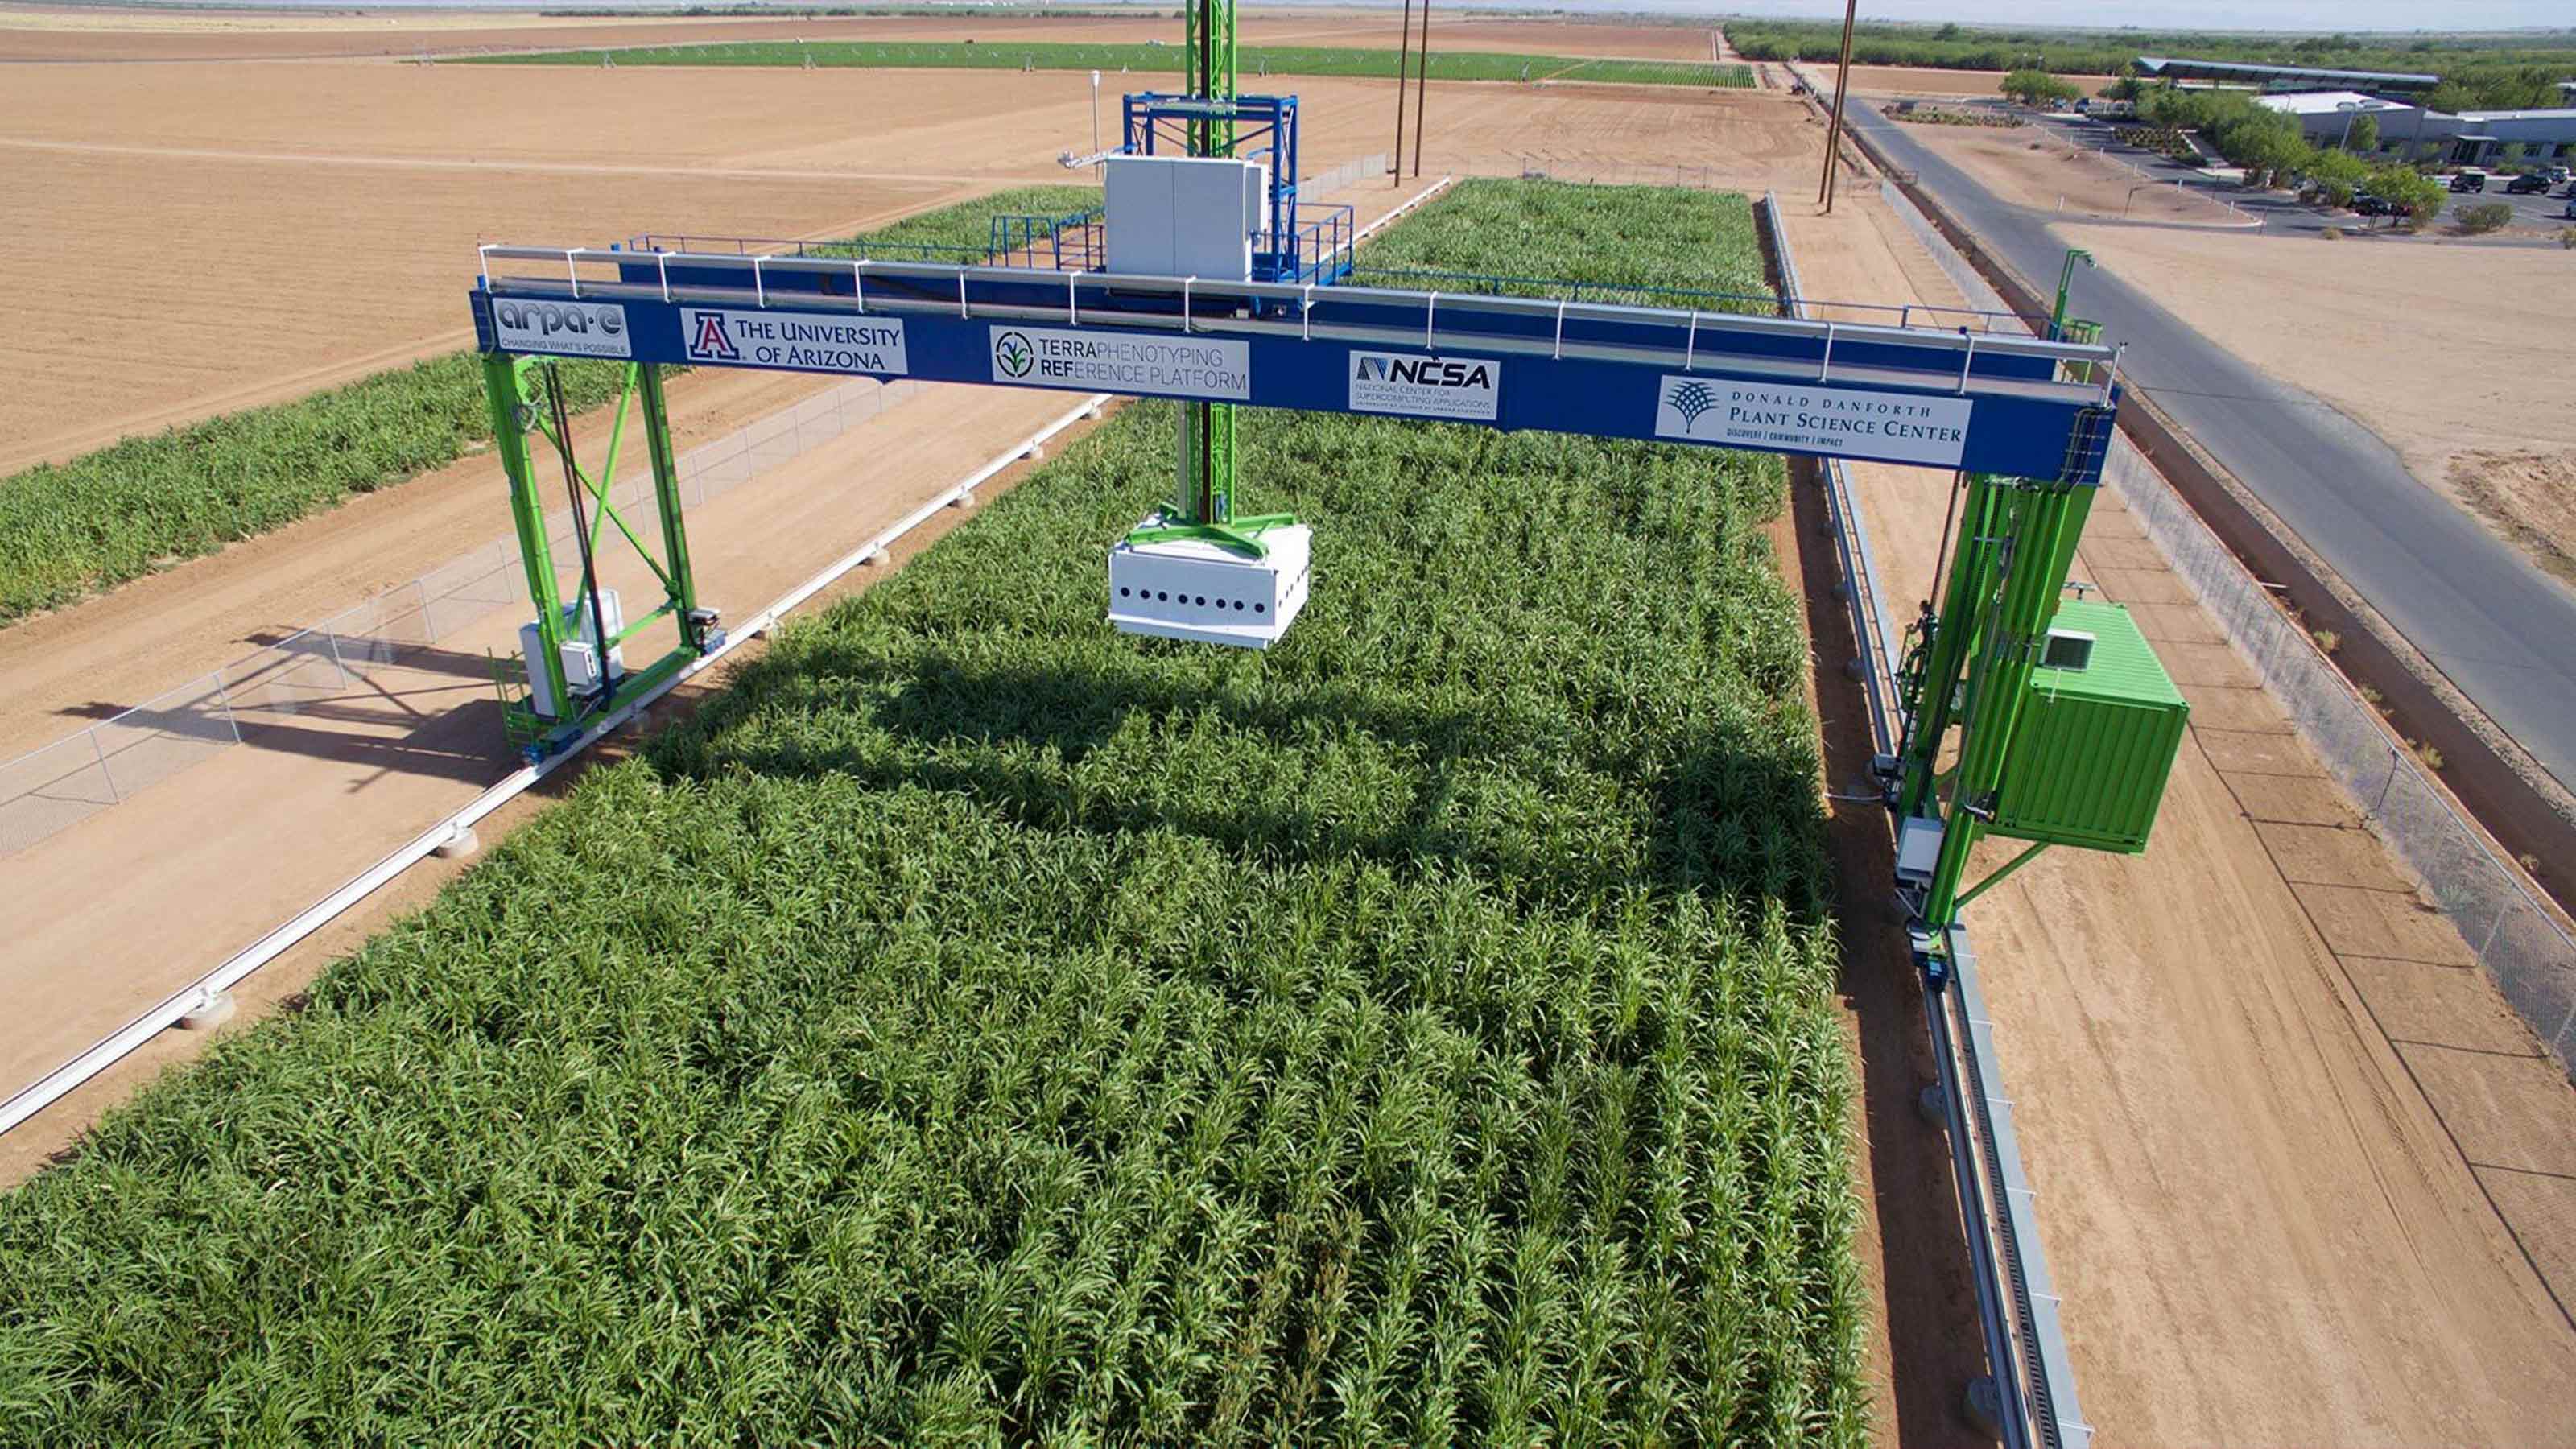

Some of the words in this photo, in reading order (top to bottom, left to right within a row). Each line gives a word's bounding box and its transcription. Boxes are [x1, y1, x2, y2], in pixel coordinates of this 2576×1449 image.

[502, 338, 548, 349] CHANGING
[584, 342, 626, 354] POSSIBLE
[736, 320, 775, 340] THE
[782, 322, 900, 347] UNIVERSITY
[756, 346, 781, 363] OF
[787, 346, 886, 370] ARIZONA
[1041, 360, 1144, 384] REFERENCE
[1150, 366, 1246, 390] PLATFORM
[1389, 359, 1490, 389] NCSA
[1356, 384, 1397, 394] NATIONAL
[1399, 386, 1432, 395] CENTER
[1433, 388, 1450, 397] FOR
[1356, 392, 1430, 404] SUPERCOMPUTING
[1732, 391, 1810, 407] DONALD
[1823, 398, 1931, 418] DANFORTH
[1730, 407, 1790, 427] PLANT
[1797, 412, 1876, 434] SCIENCE
[1884, 420, 1961, 443] CENTER
